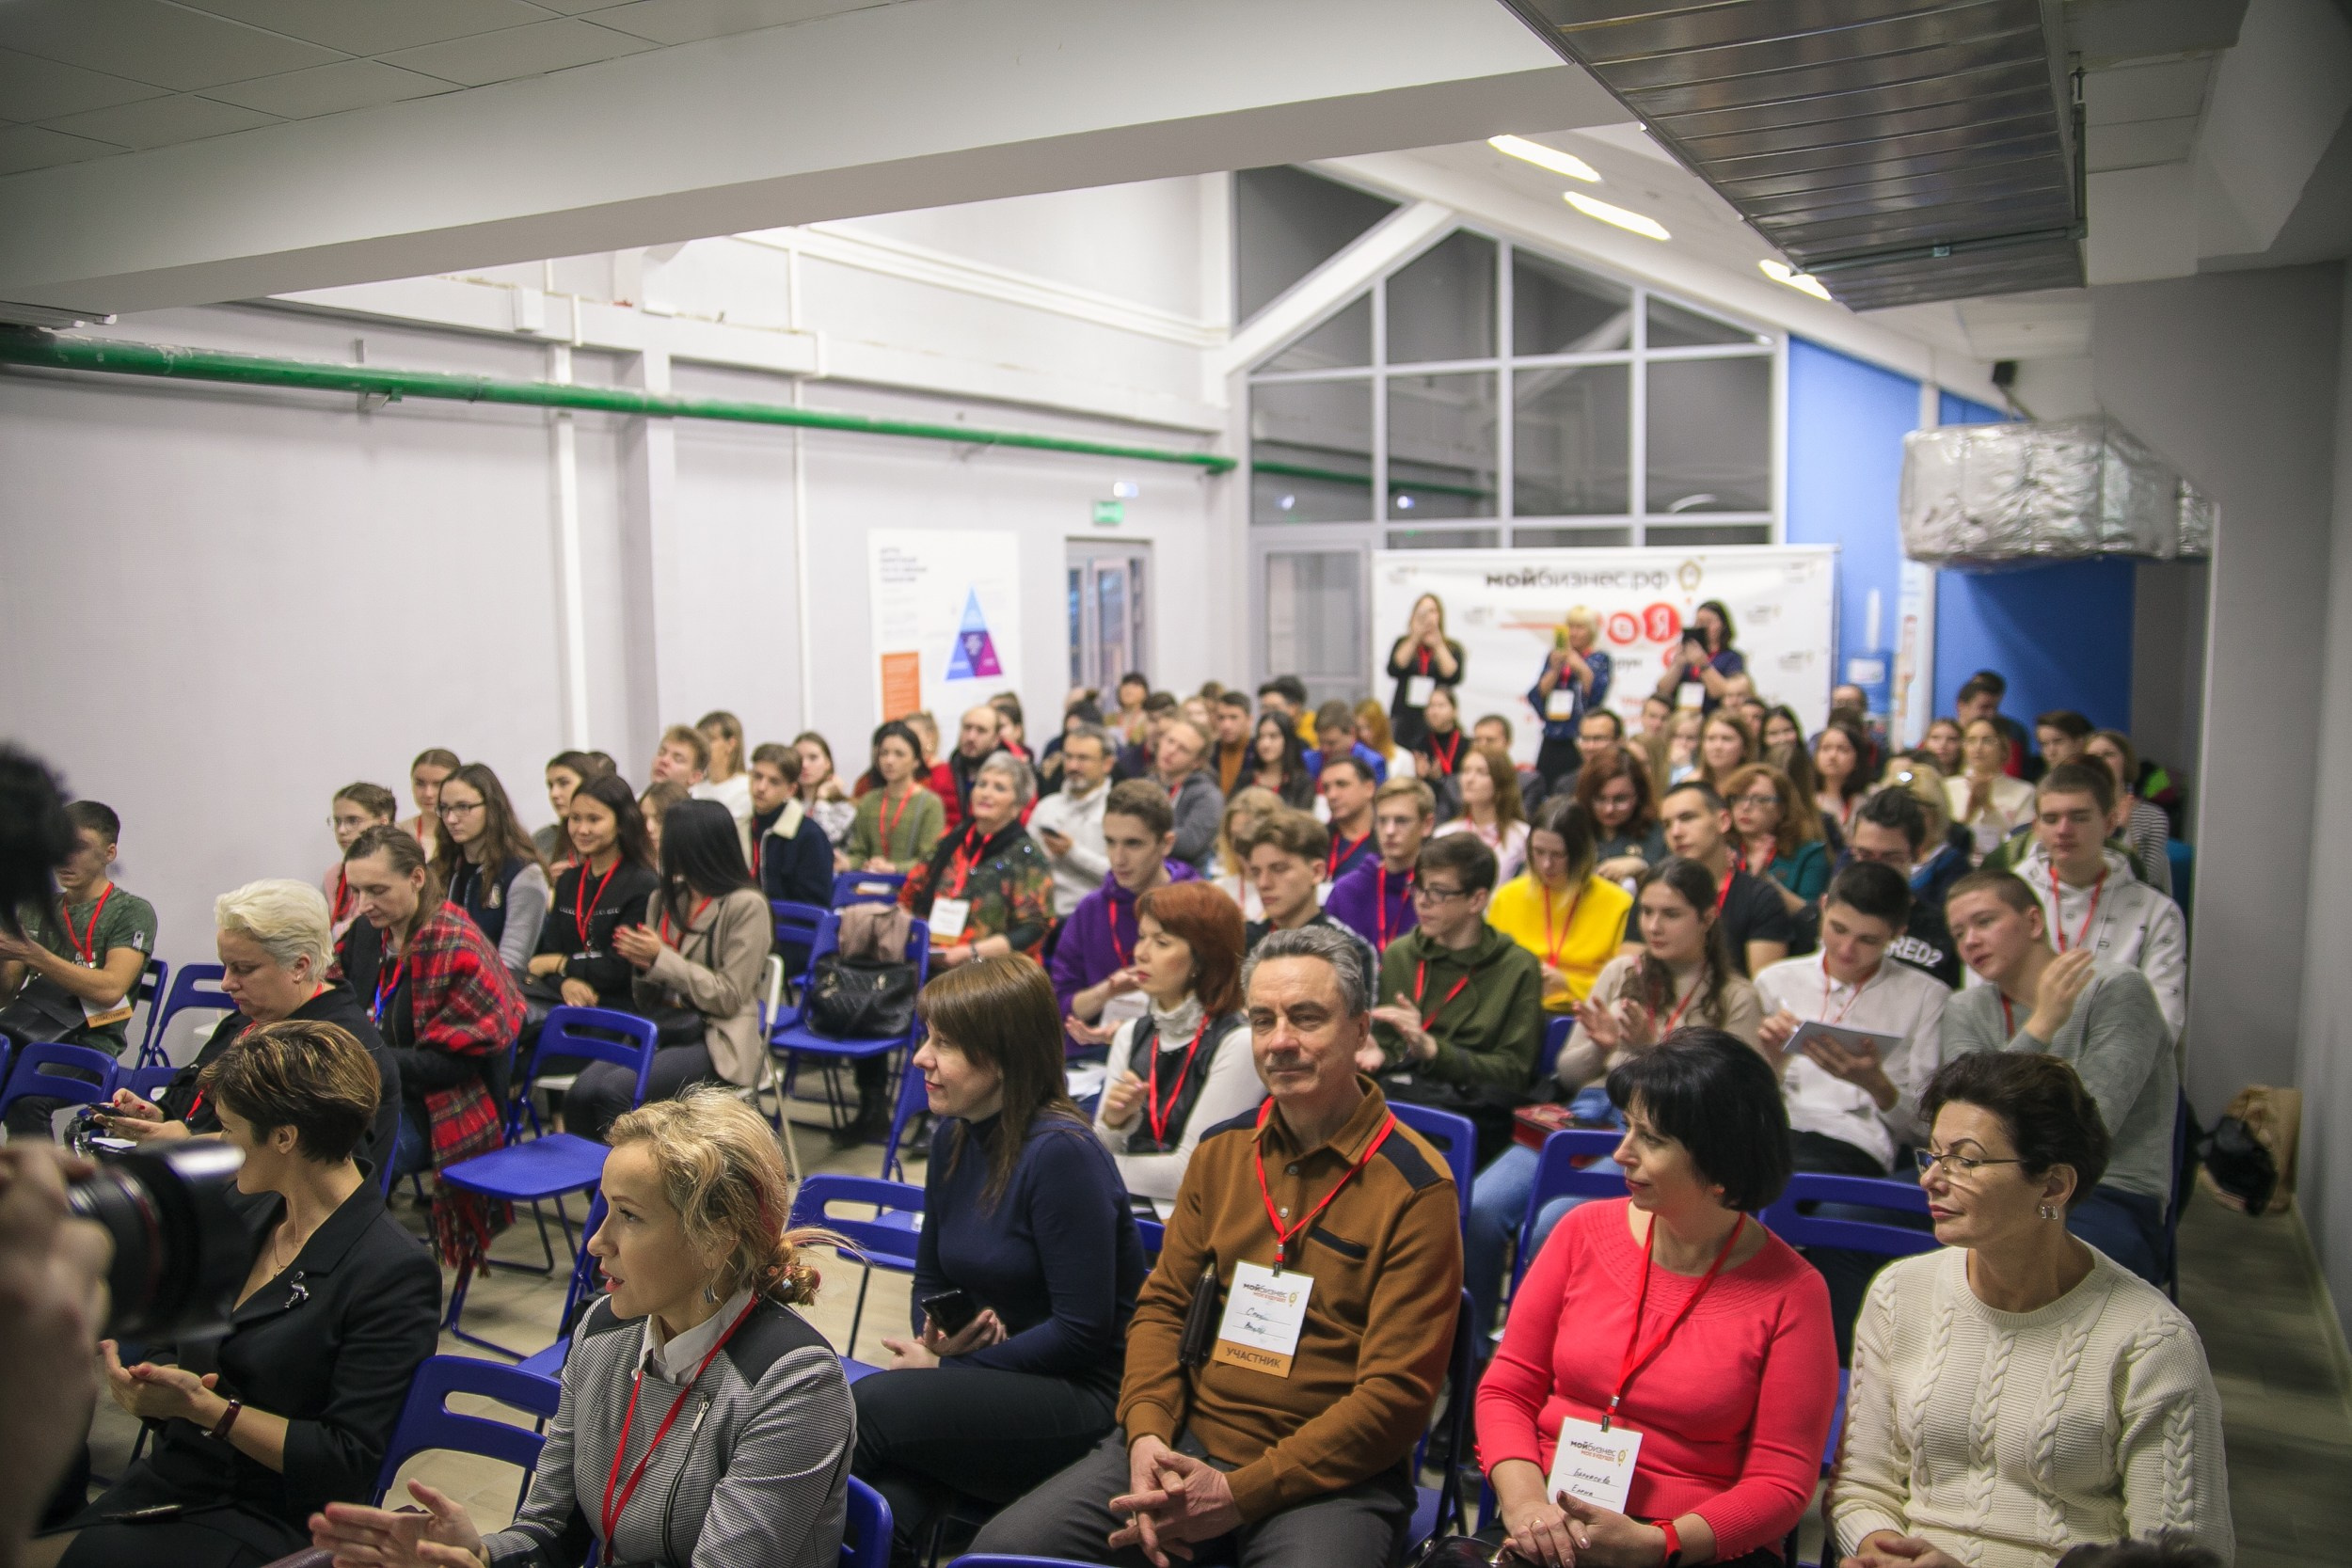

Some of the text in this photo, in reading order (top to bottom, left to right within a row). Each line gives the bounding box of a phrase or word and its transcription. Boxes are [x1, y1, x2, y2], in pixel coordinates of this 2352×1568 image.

[1486, 566, 1670, 590] мойбизнес.рф
[1226, 1347, 1280, 1368] УЧАСТНИК
[1570, 1440, 1616, 1457] мойбизнес
